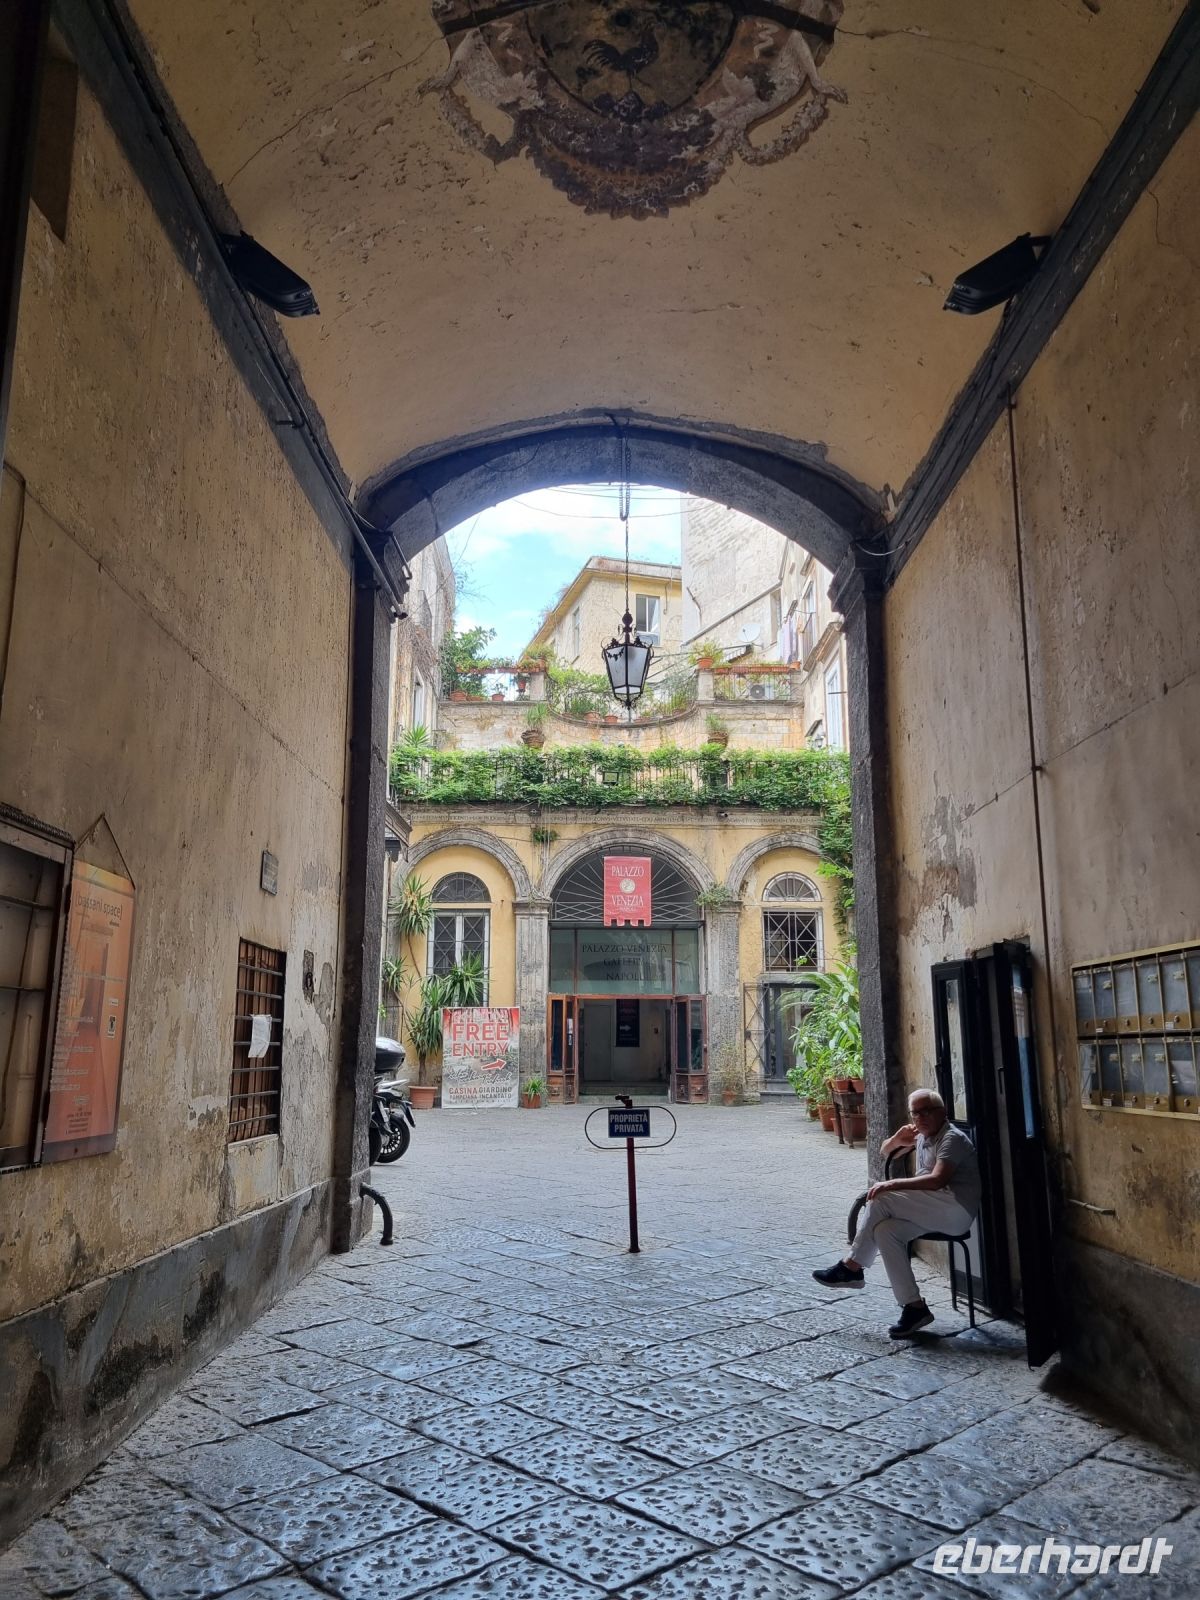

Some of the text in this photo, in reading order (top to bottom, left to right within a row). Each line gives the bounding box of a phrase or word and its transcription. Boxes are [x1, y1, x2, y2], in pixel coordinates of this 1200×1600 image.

[612, 866, 644, 877] PALAZZO
[611, 895, 644, 906] VENEZIA
[582, 944, 667, 953] PALAZZO VENEZIA
[452, 1023, 509, 1041] FREE
[452, 1042, 508, 1057] ENTRY
[448, 1087, 478, 1095] CASINA
[610, 1112, 648, 1122] PROPRIETÀ
[614, 1124, 644, 1133] PRIVATA
